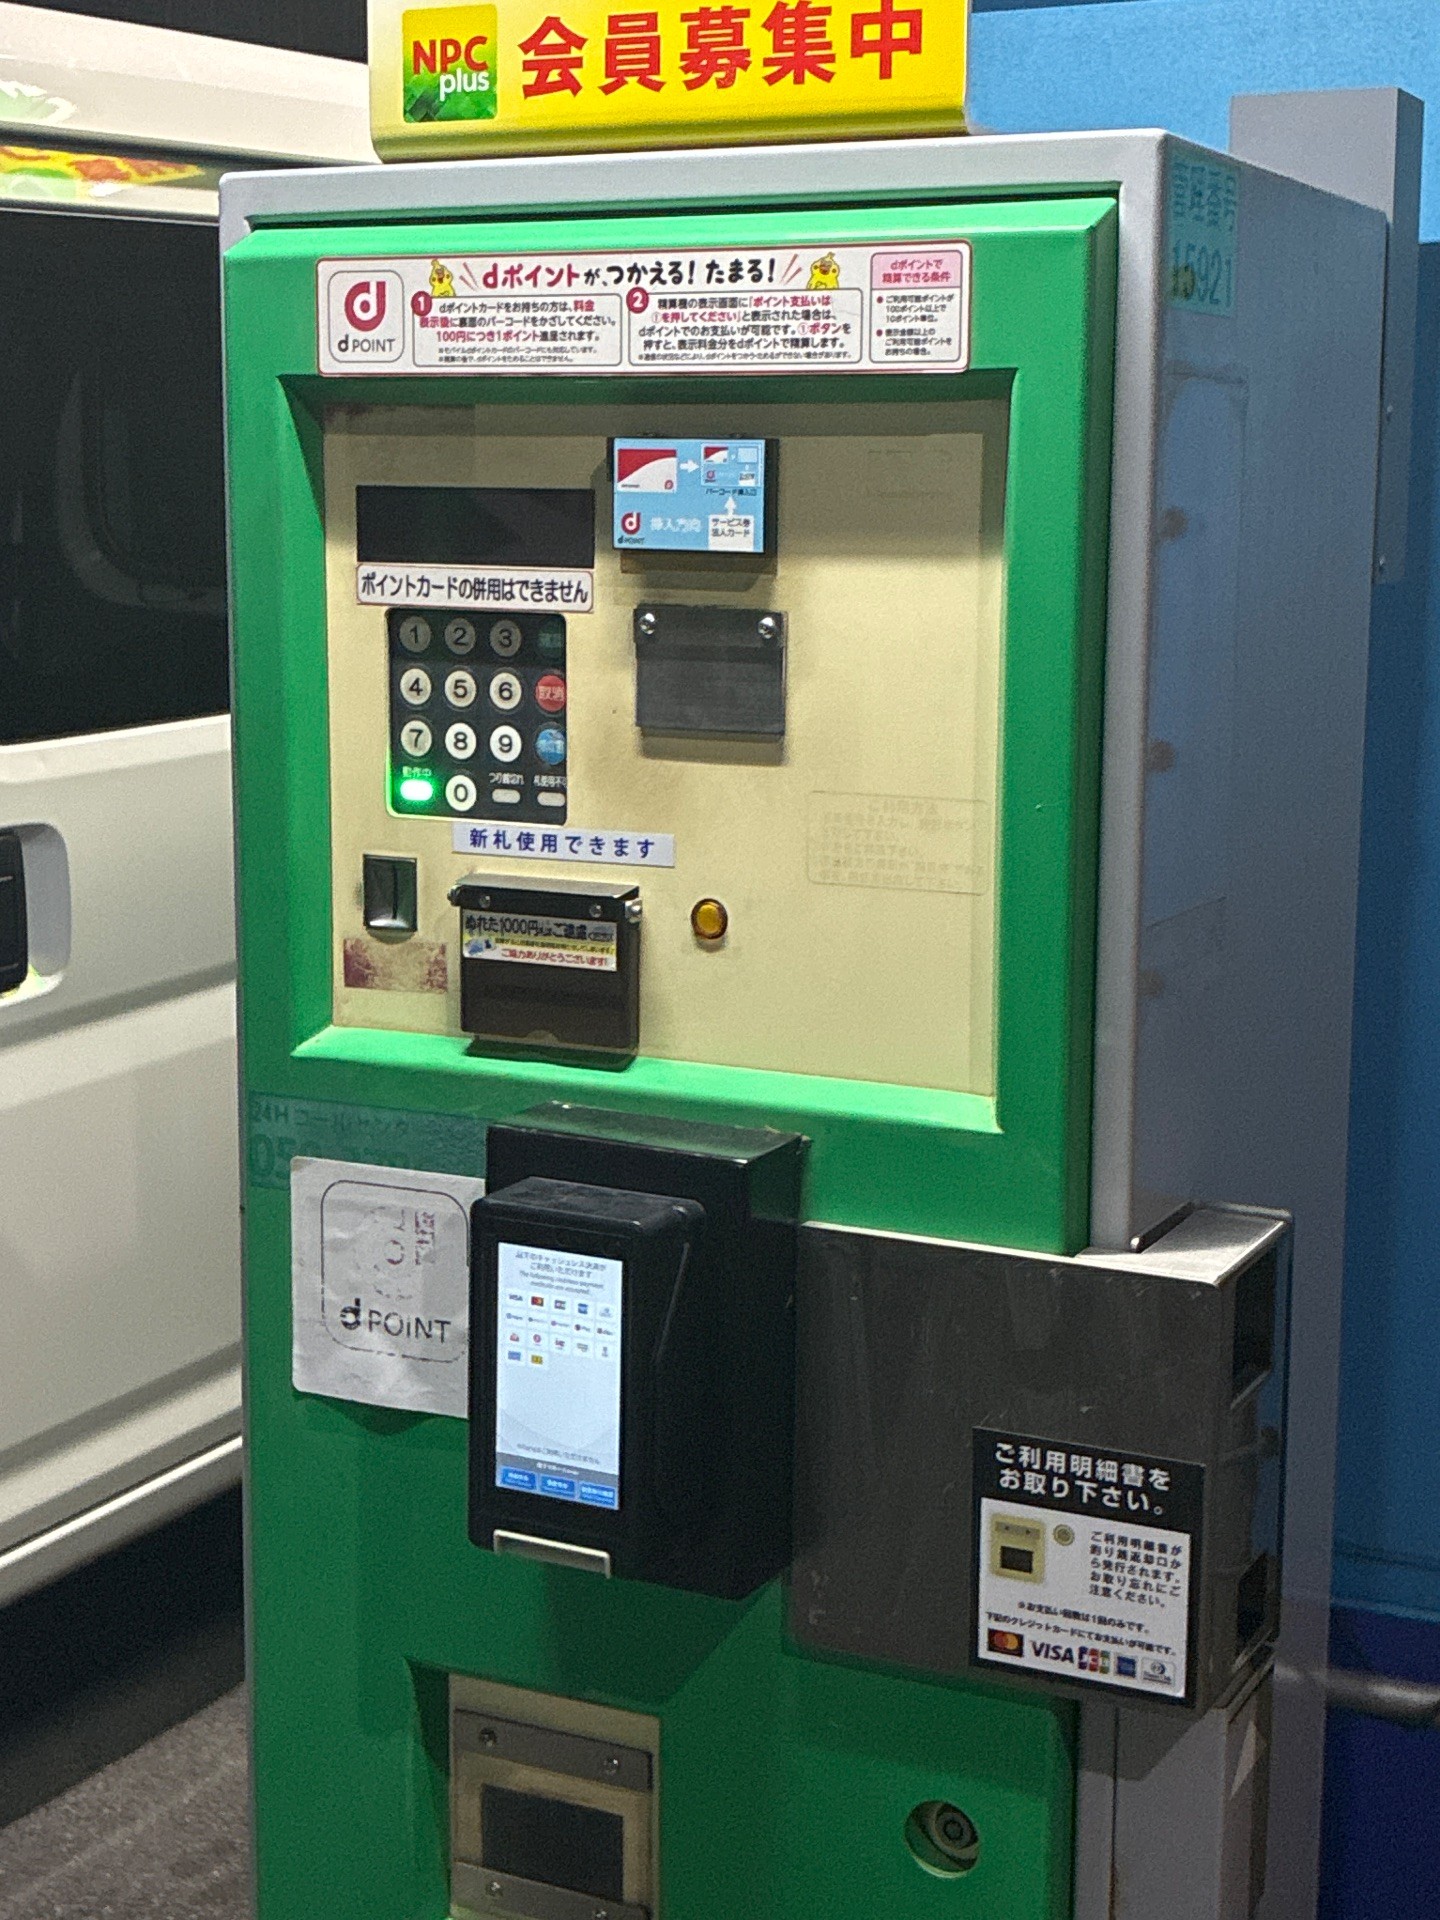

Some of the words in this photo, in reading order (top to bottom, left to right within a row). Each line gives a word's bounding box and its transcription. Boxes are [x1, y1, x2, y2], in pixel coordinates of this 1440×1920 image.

[412, 36, 488, 76] NPC
[518, 0, 923, 99] 会員募集中
[439, 68, 489, 101] plus
[706, 258, 775, 286] たまる！
[890, 258, 944, 271] dポイントで
[361, 571, 590, 604] ポイントカードの併用はできません
[454, 629, 467, 647] 2
[500, 630, 513, 648] 3
[409, 678, 423, 696] 4
[454, 680, 467, 699] 5
[499, 682, 513, 701] 6
[409, 729, 423, 748] 7
[454, 732, 467, 751] 8
[499, 735, 512, 753] 9
[454, 783, 467, 803] 0
[469, 828, 655, 858] 新札使用できます
[995, 1442, 1170, 1492] ご利用明細書を
[999, 1467, 1163, 1516] お取り下さい。
[1090, 1531, 1182, 1556] ご利用明細書が
[1088, 1583, 1165, 1608] 注意ください。
[1090, 1570, 1182, 1598] お取り忘れにご
[1031, 1641, 1075, 1665] VISA
